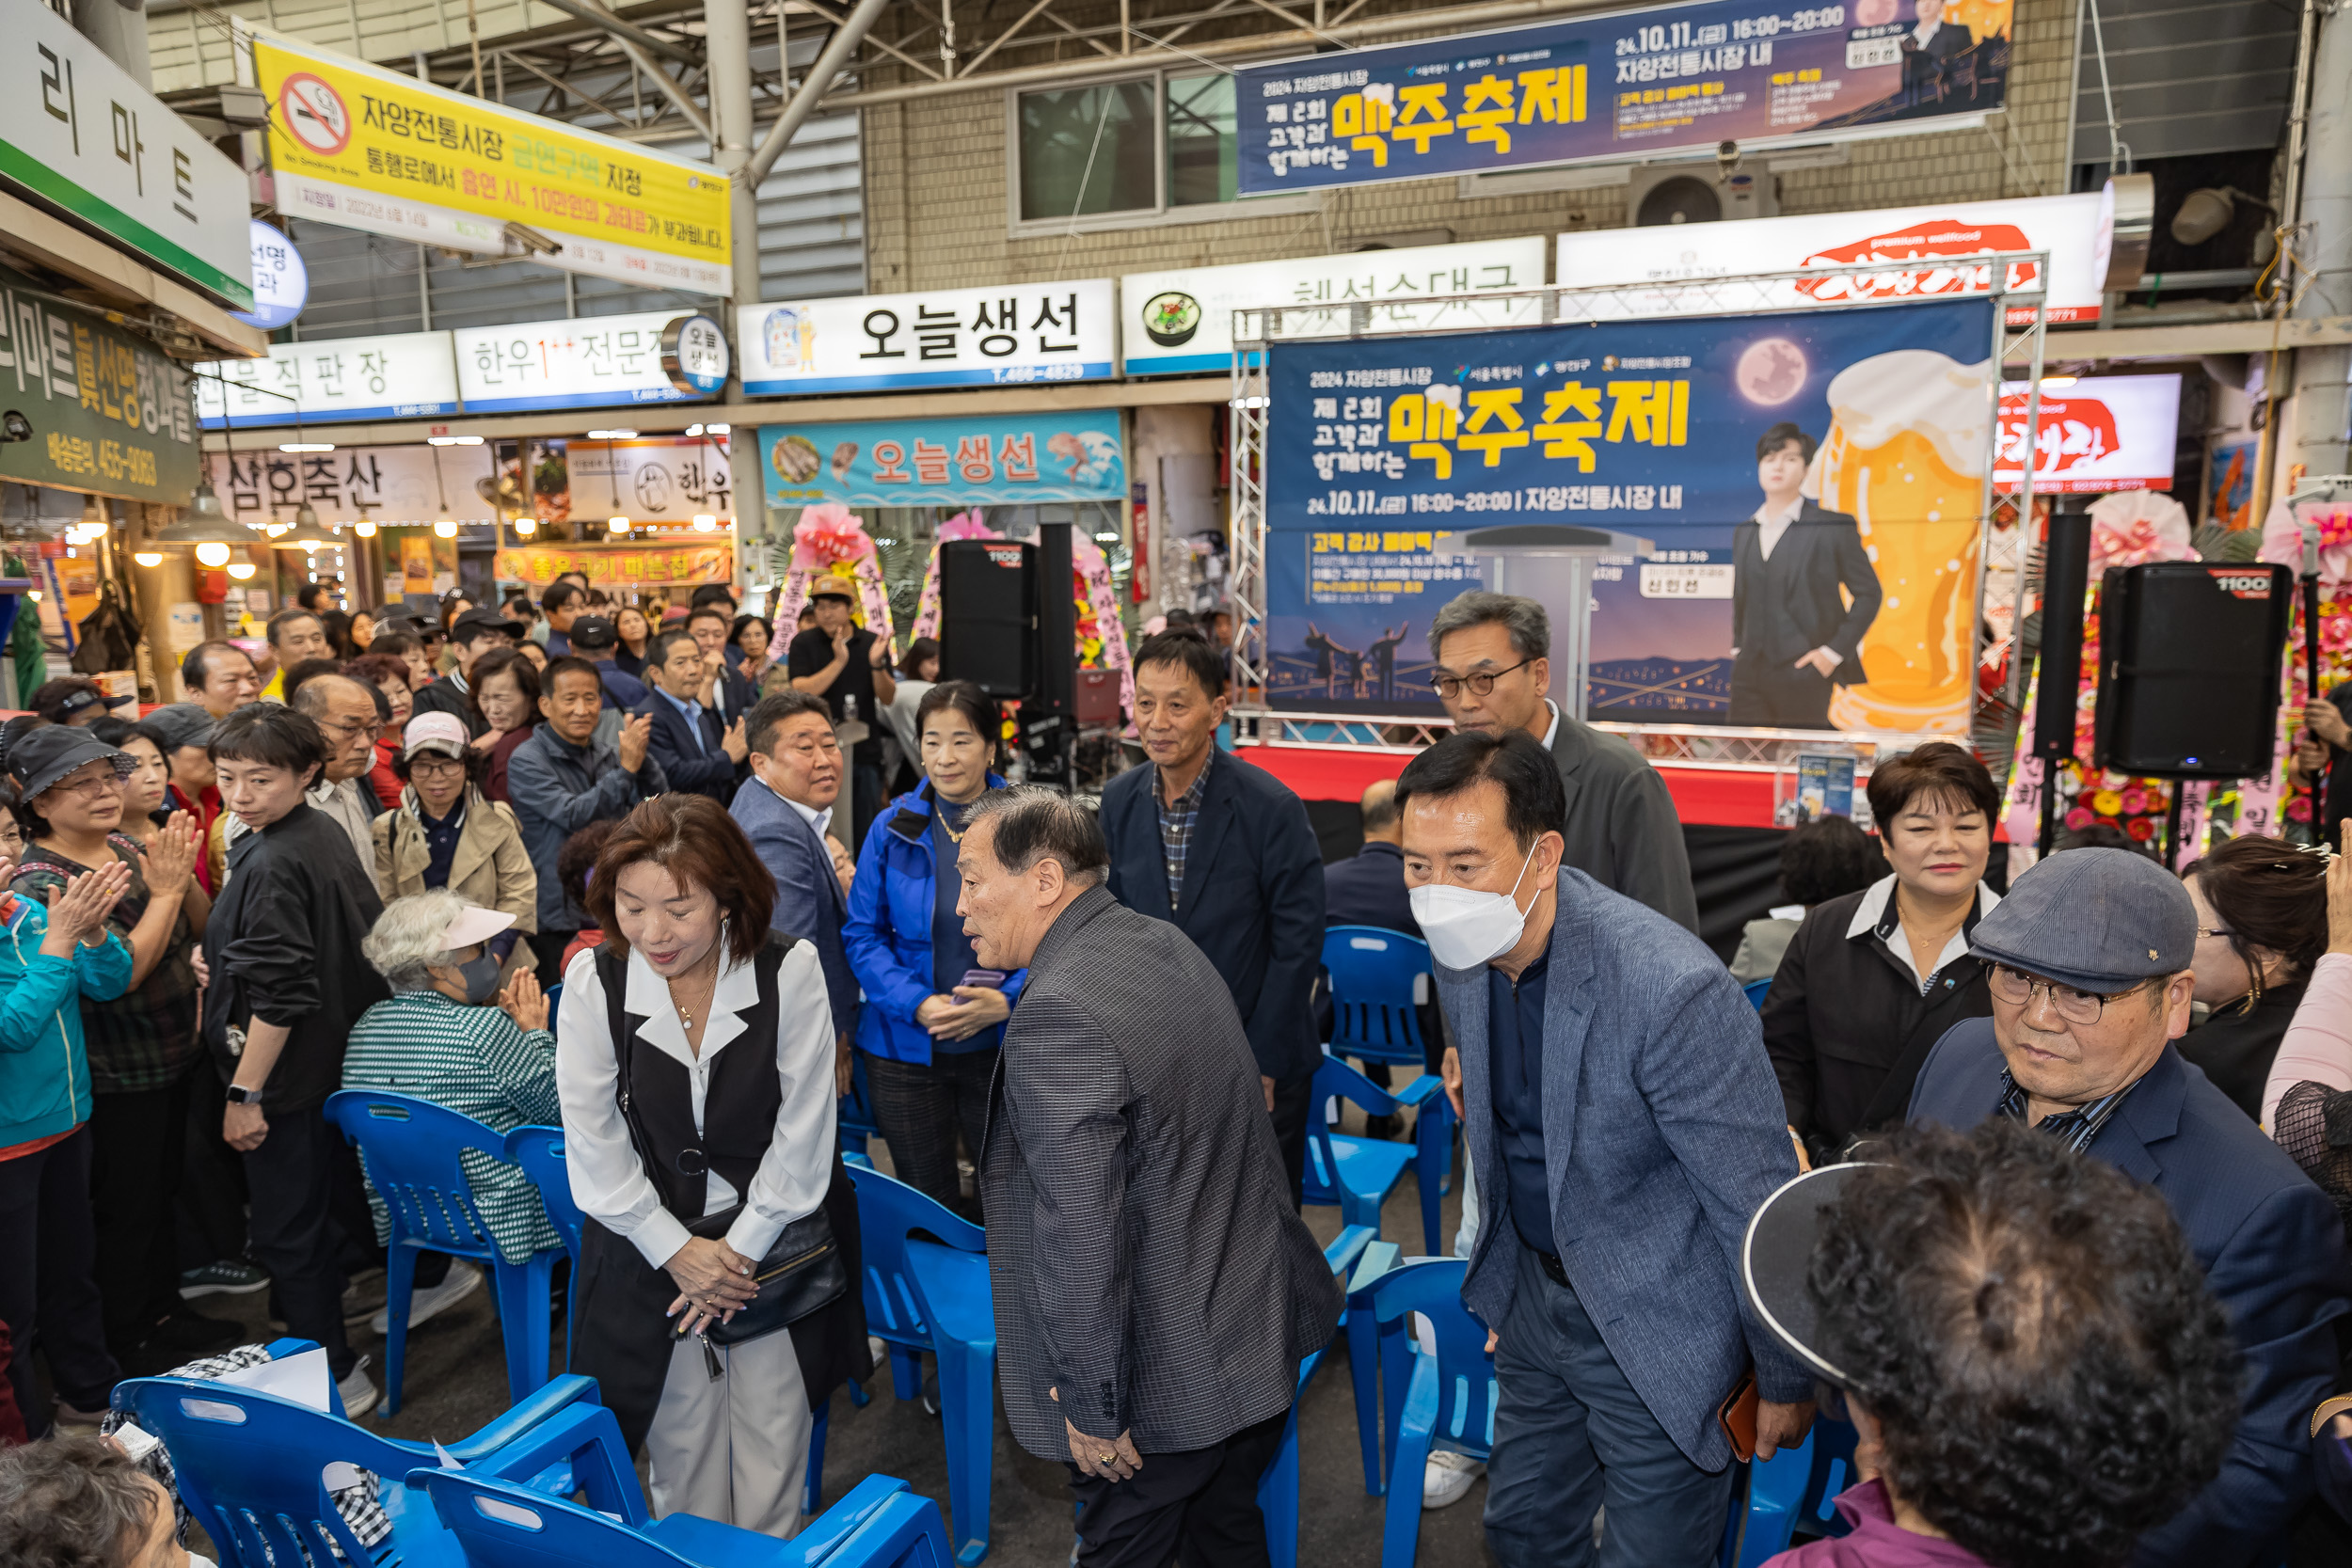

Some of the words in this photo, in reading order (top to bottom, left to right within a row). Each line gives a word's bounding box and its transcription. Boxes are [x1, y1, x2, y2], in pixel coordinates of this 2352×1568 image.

[1732, 6, 1845, 40] 16:00~20:00
[1615, 45, 1747, 85] 자양전통시장
[1750, 41, 1772, 67] 내
[1263, 79, 1292, 97] 2024
[1294, 71, 1369, 93] 자양전통시장
[1266, 103, 1288, 122] 제
[360, 94, 503, 161] 자양전통시장
[512, 135, 599, 187] 금연구역
[606, 164, 642, 197] 지정
[1267, 122, 1328, 150] 고객과
[366, 147, 455, 191] 통행로에서
[461, 167, 497, 199] 흡연
[1267, 145, 1350, 177] 함께하는
[1870, 235, 1926, 249] premium
[1927, 230, 1981, 245] wellfood
[860, 293, 1079, 361] 오늘생선
[1310, 372, 1343, 388] 2024
[1344, 367, 1433, 388] 자양전통시장
[1312, 397, 1338, 420] 제
[1312, 424, 1383, 452] 고객과
[871, 432, 1040, 485] 오늘생선
[1312, 451, 1406, 481] 함께하는
[1411, 491, 1513, 513] 16:00~20:00
[1526, 485, 1657, 512] 자양전통시장
[1660, 485, 1683, 510] 내
